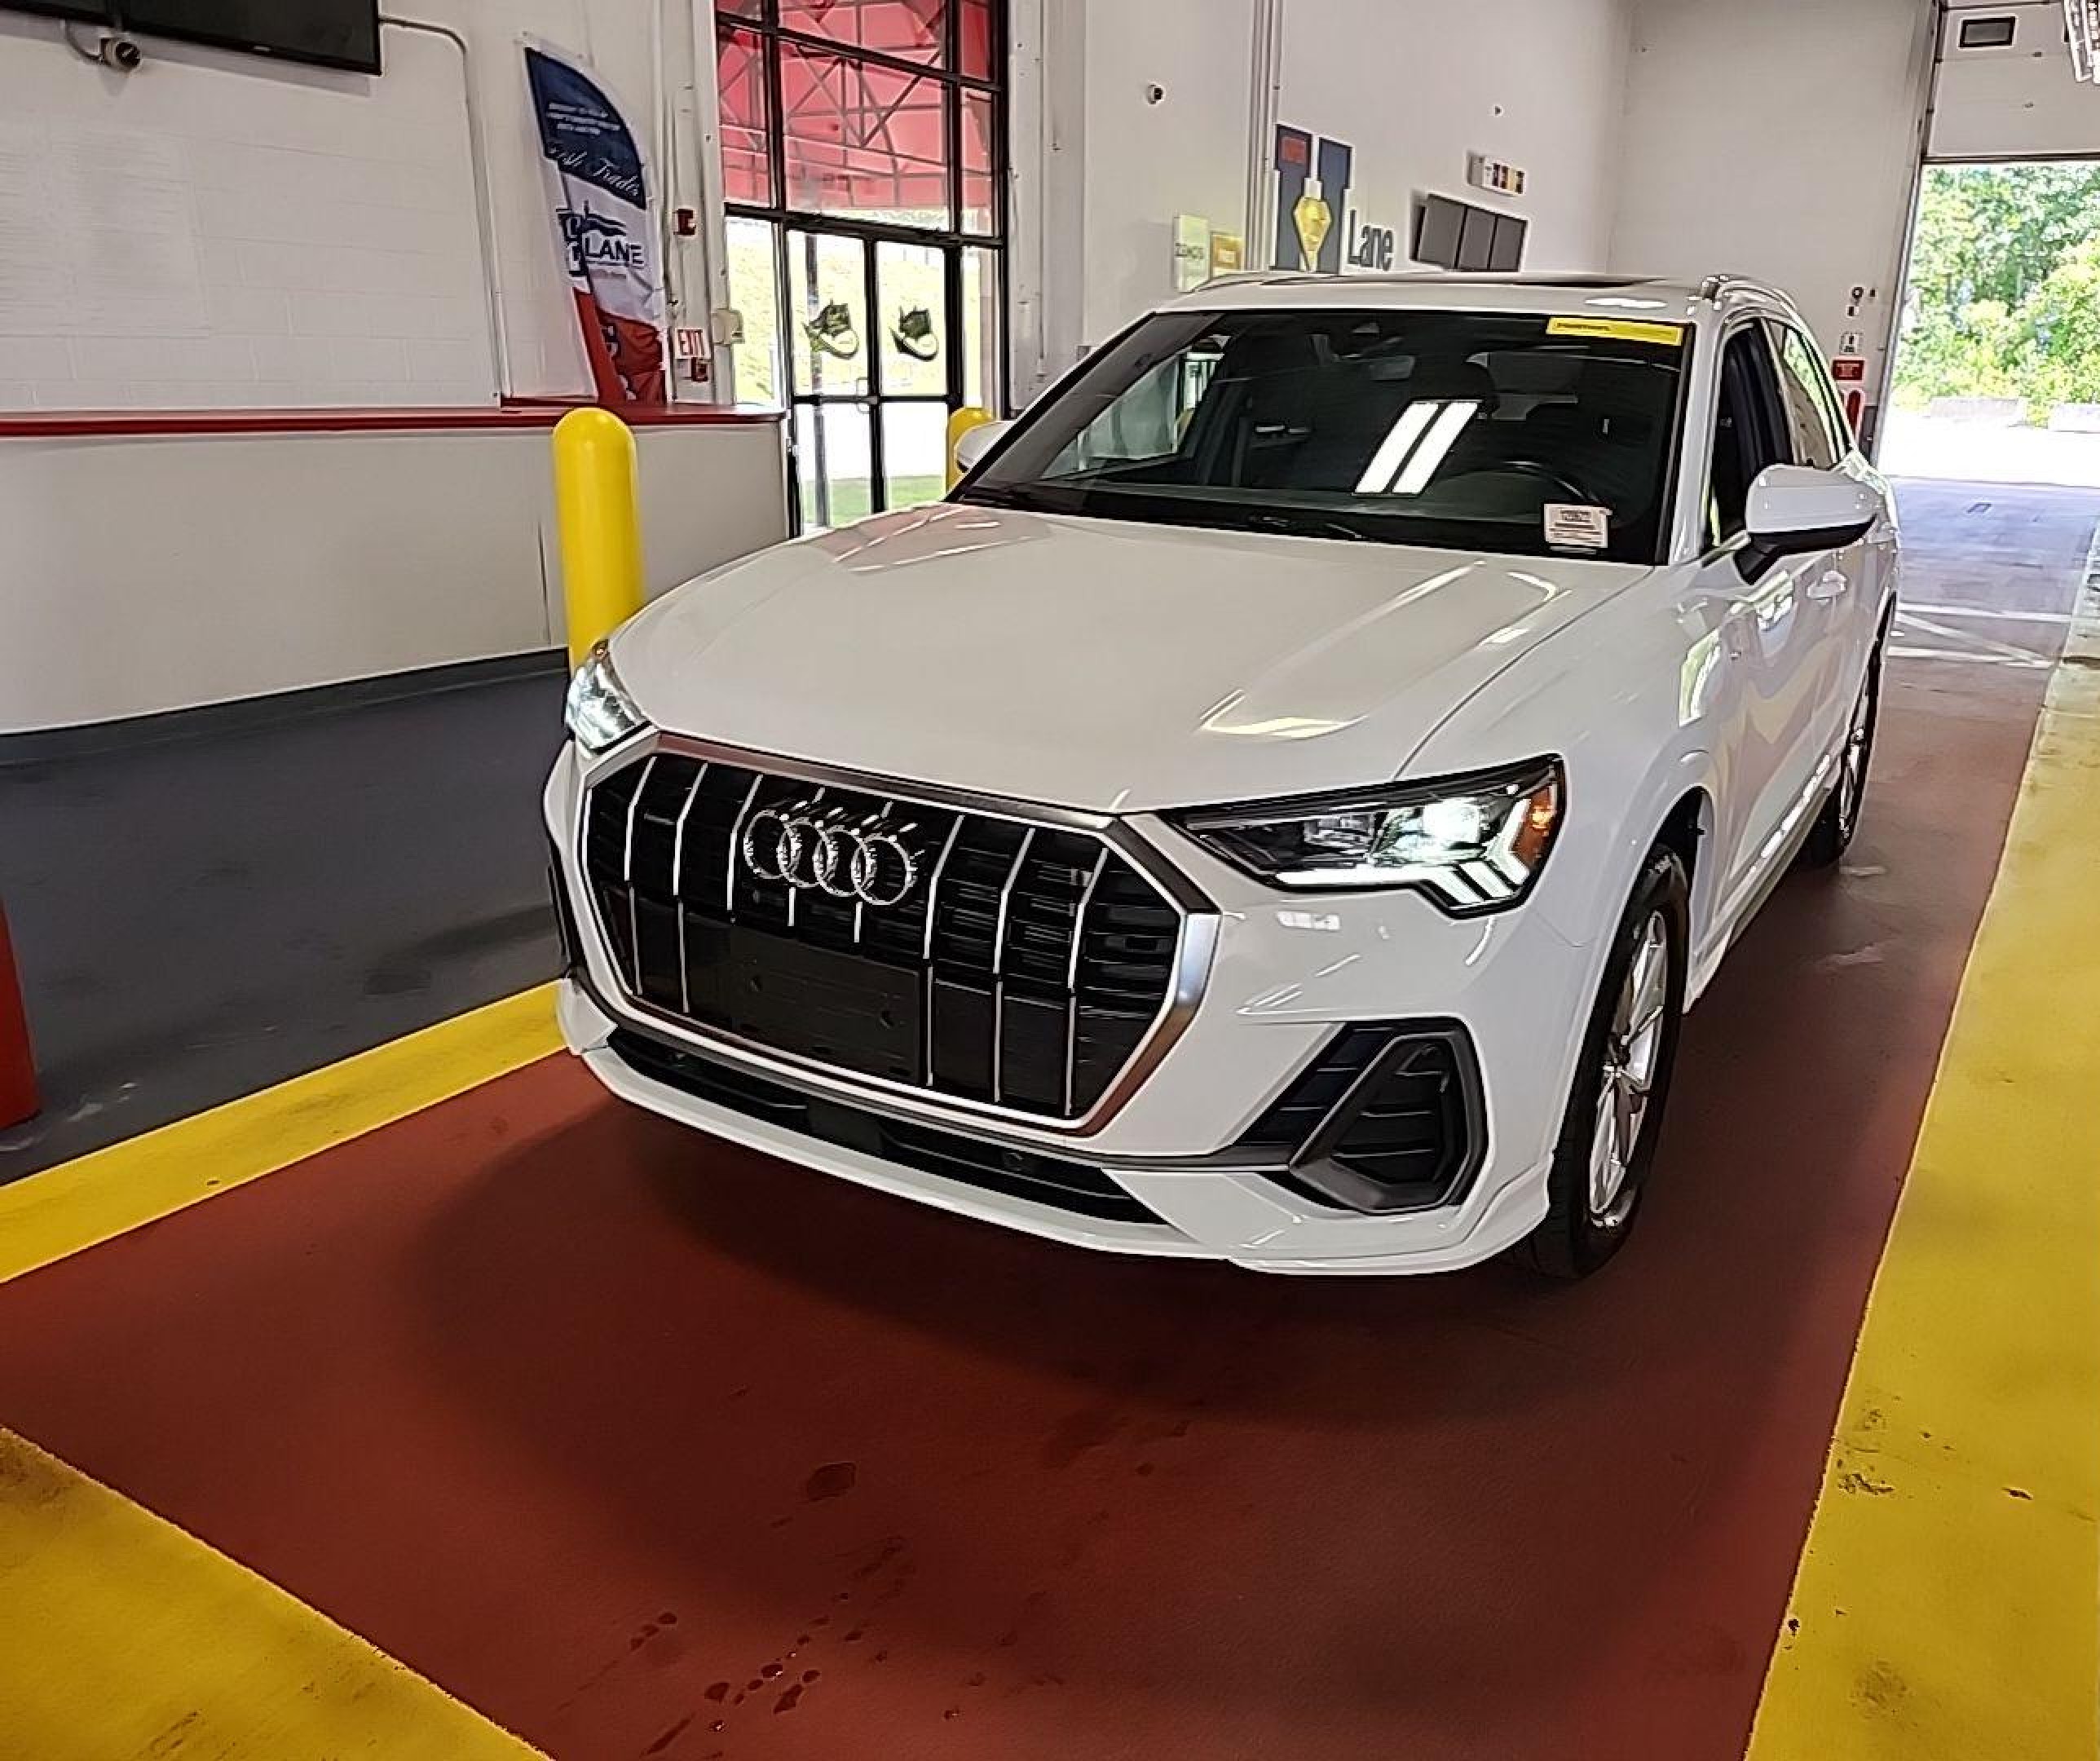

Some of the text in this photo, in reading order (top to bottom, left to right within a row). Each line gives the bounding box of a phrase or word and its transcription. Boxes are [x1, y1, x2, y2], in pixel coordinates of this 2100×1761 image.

[585, 236, 644, 266] LANE
[1348, 209, 1393, 271] Lane
[677, 329, 705, 355] EXIT
